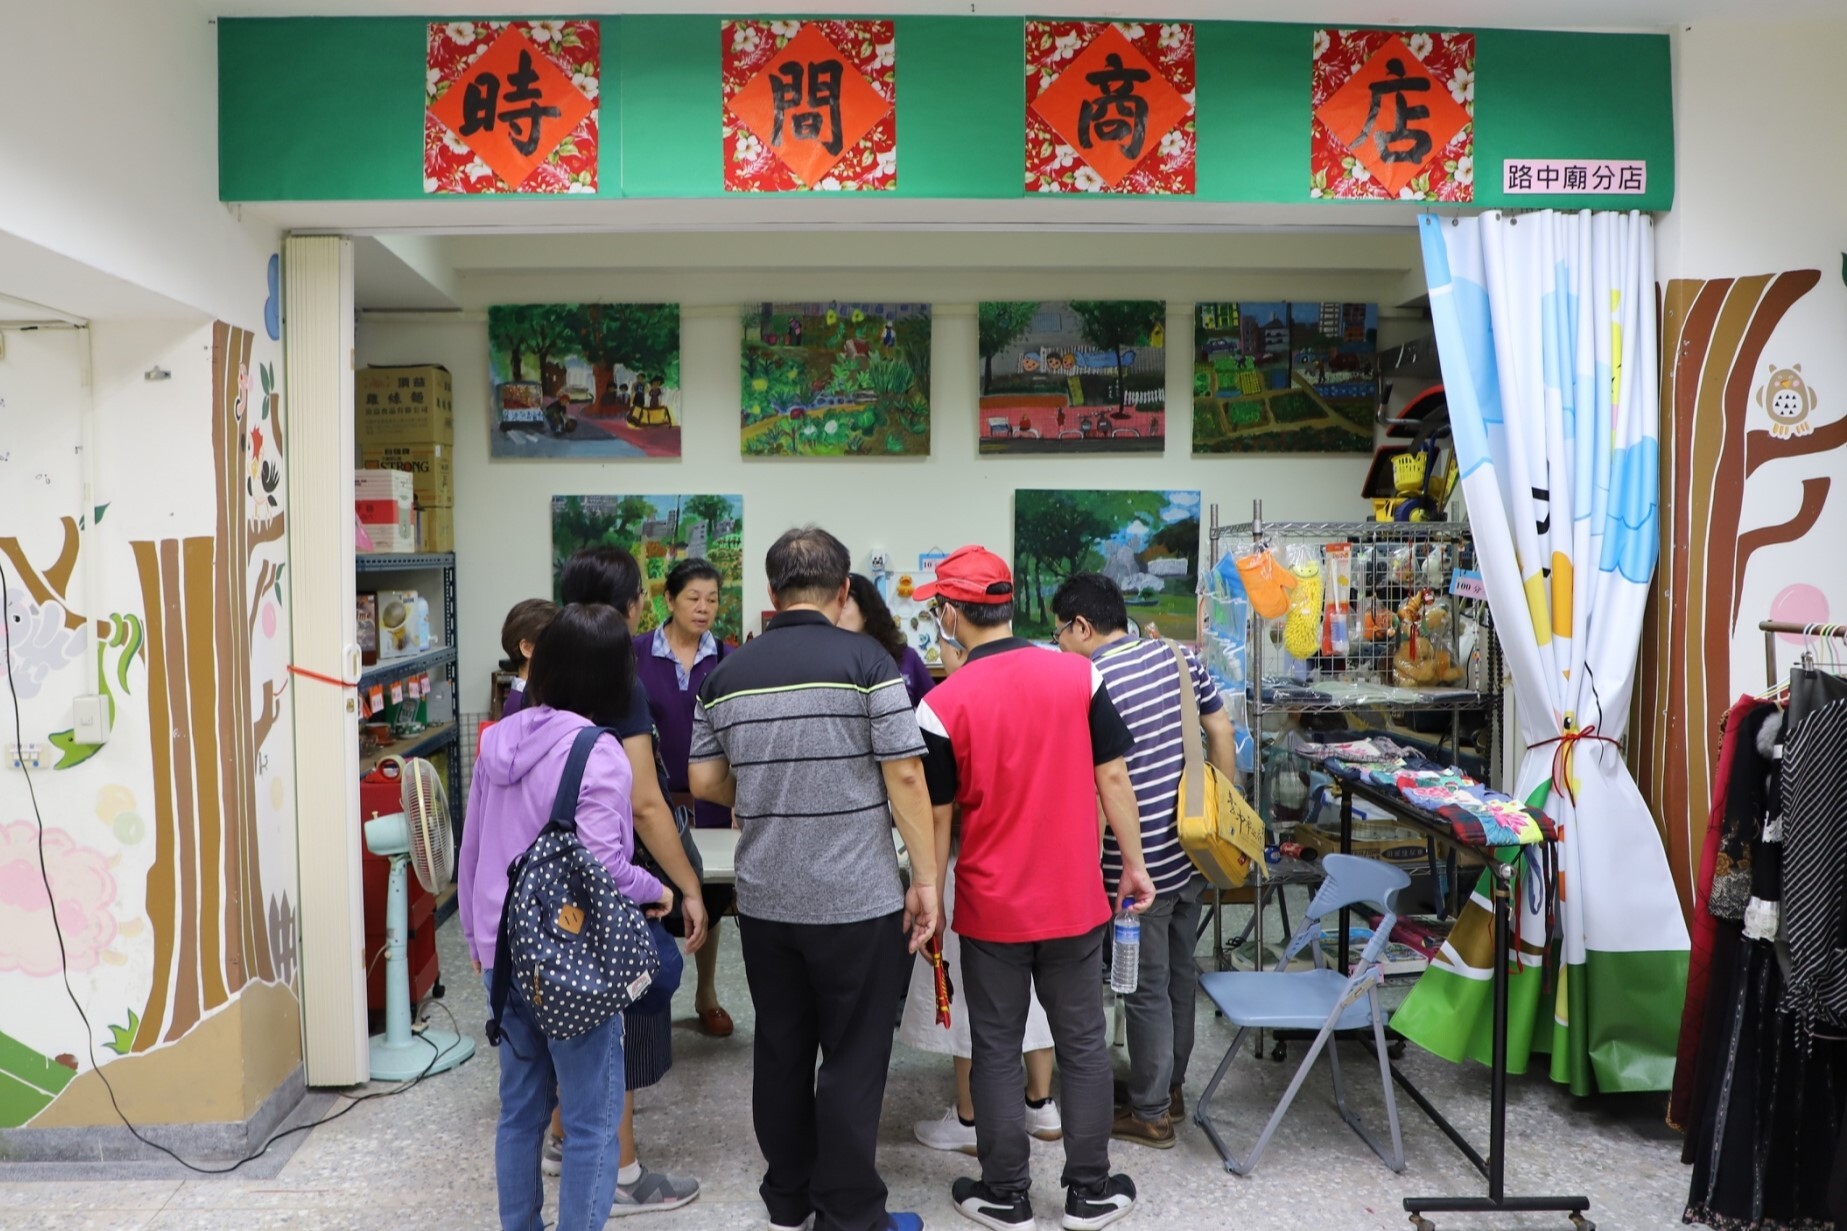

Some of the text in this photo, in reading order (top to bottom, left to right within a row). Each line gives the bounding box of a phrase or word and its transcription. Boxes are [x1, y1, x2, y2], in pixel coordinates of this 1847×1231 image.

[1509, 165, 1643, 190] 路中廟分店
[380, 460, 429, 473] STRONG
[1456, 581, 1472, 591] 100
